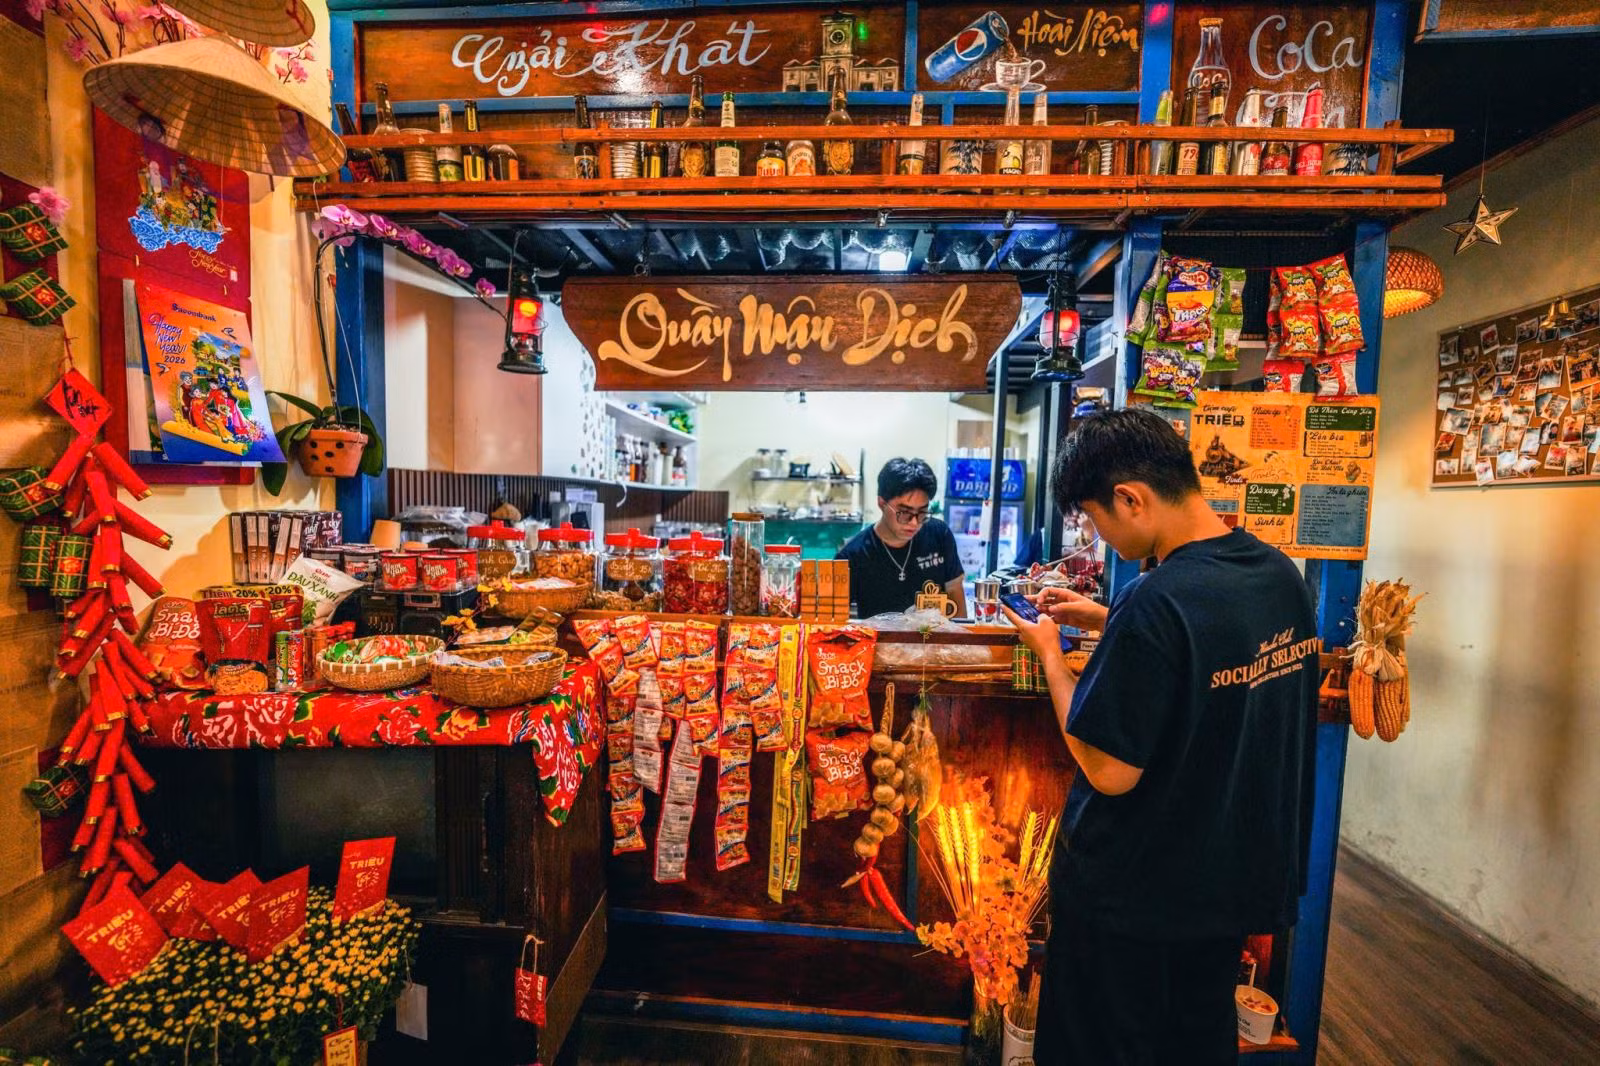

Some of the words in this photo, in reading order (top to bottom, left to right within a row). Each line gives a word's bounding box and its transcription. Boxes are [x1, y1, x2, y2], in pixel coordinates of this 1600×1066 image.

[1017, 9, 1073, 51] Hoài
[1054, 8, 1139, 57] Niệm
[555, 17, 771, 77] Khát
[1250, 15, 1363, 79] CoCa
[172, 303, 217, 322] Sacombank
[598, 287, 732, 382] Quầy
[842, 284, 977, 365] Dịch
[164, 355, 186, 365] 2026
[1263, 487, 1279, 497] xay
[309, 583, 340, 601] XANH
[155, 608, 199, 624] Sna
[817, 659, 867, 677] Snack
[1210, 655, 1269, 689] SOCIALLY
[1271, 637, 1318, 669] SELECTIV
[818, 747, 863, 769] Snack
